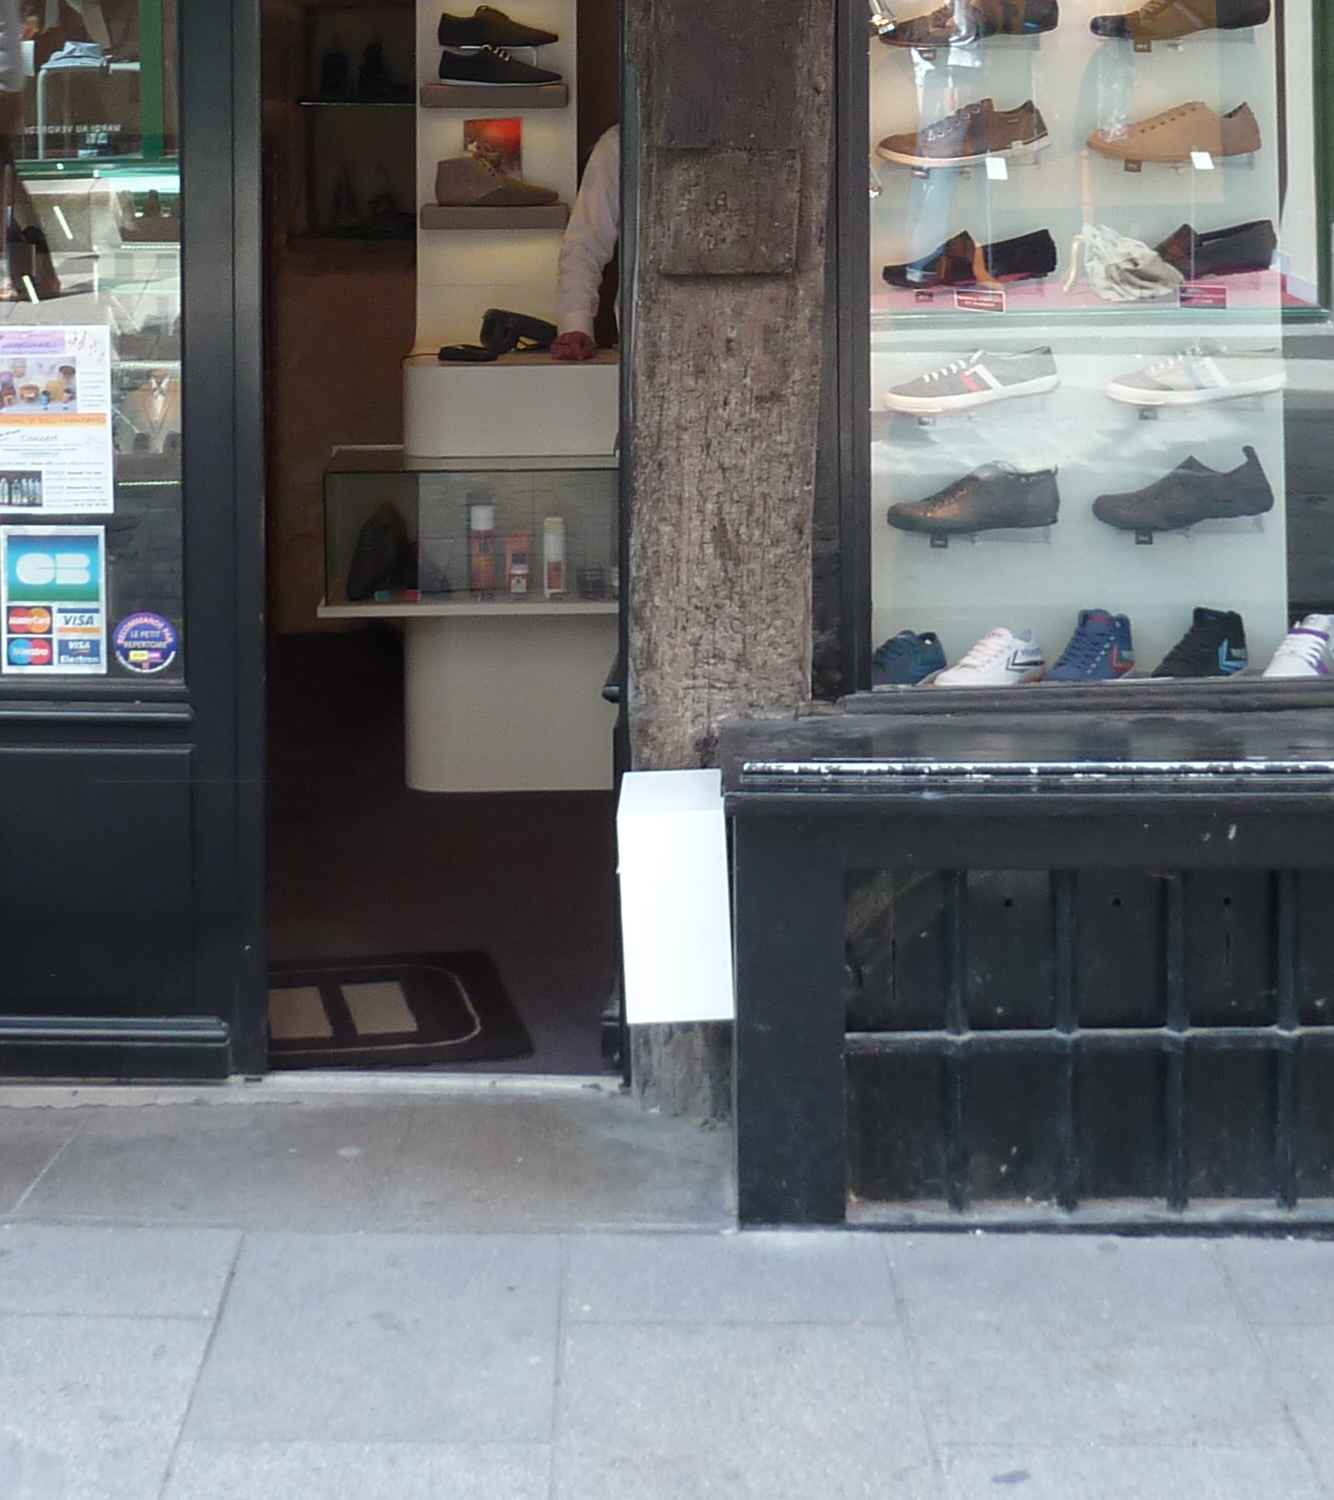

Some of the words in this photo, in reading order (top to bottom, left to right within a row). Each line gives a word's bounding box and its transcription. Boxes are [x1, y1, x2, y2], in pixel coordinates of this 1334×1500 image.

[16, 553, 91, 585] CB
[63, 615, 95, 626] VISA
[68, 641, 91, 650] VISA
[60, 655, 100, 664] Electron
